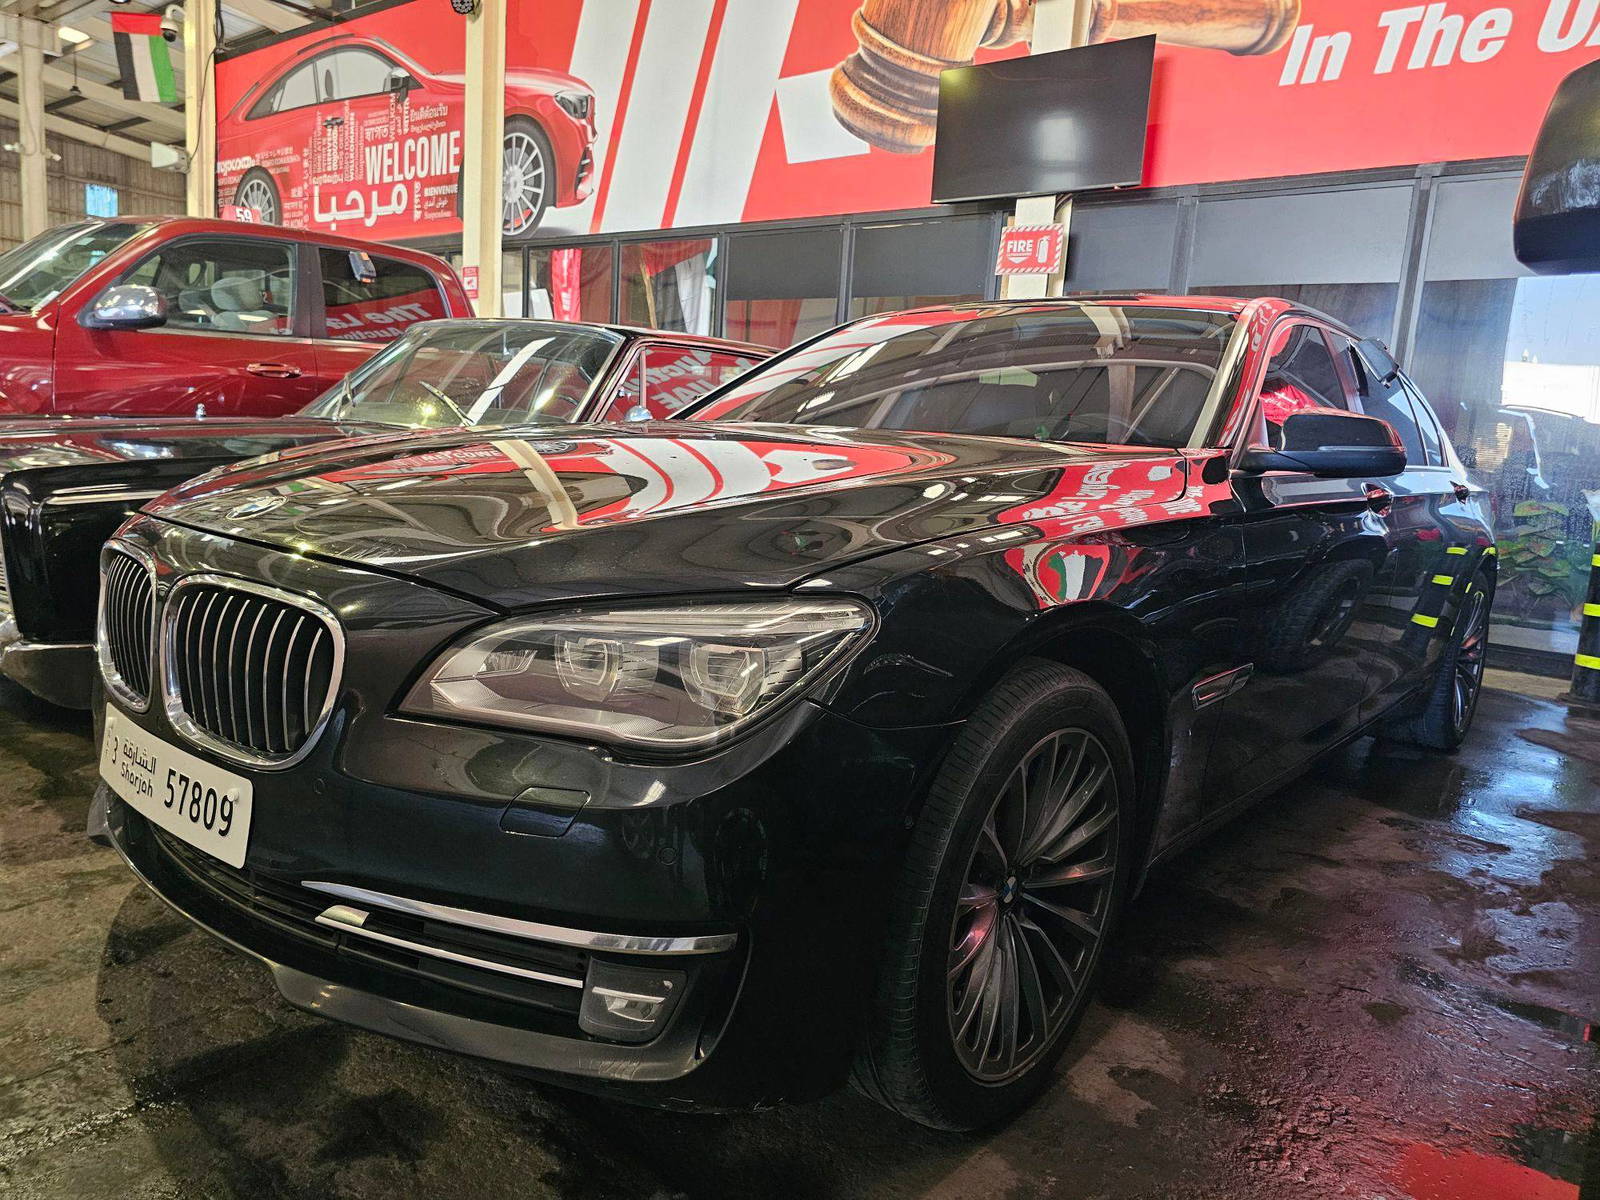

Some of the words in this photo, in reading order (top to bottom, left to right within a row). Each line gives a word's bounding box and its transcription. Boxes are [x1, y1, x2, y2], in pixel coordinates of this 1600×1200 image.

[1278, 24, 1352, 87] In
[1373, 2, 1513, 75] The
[1537, 0, 1600, 53] U
[365, 130, 461, 186] WELCOME
[314, 184, 409, 231] مرحبا
[423, 183, 459, 198] BIENVENUE
[235, 207, 254, 224] 59
[1007, 240, 1034, 253] FIRE
[123, 738, 157, 775] الشارقة
[120, 761, 154, 798] Sharjah
[163, 768, 234, 837] 57809
